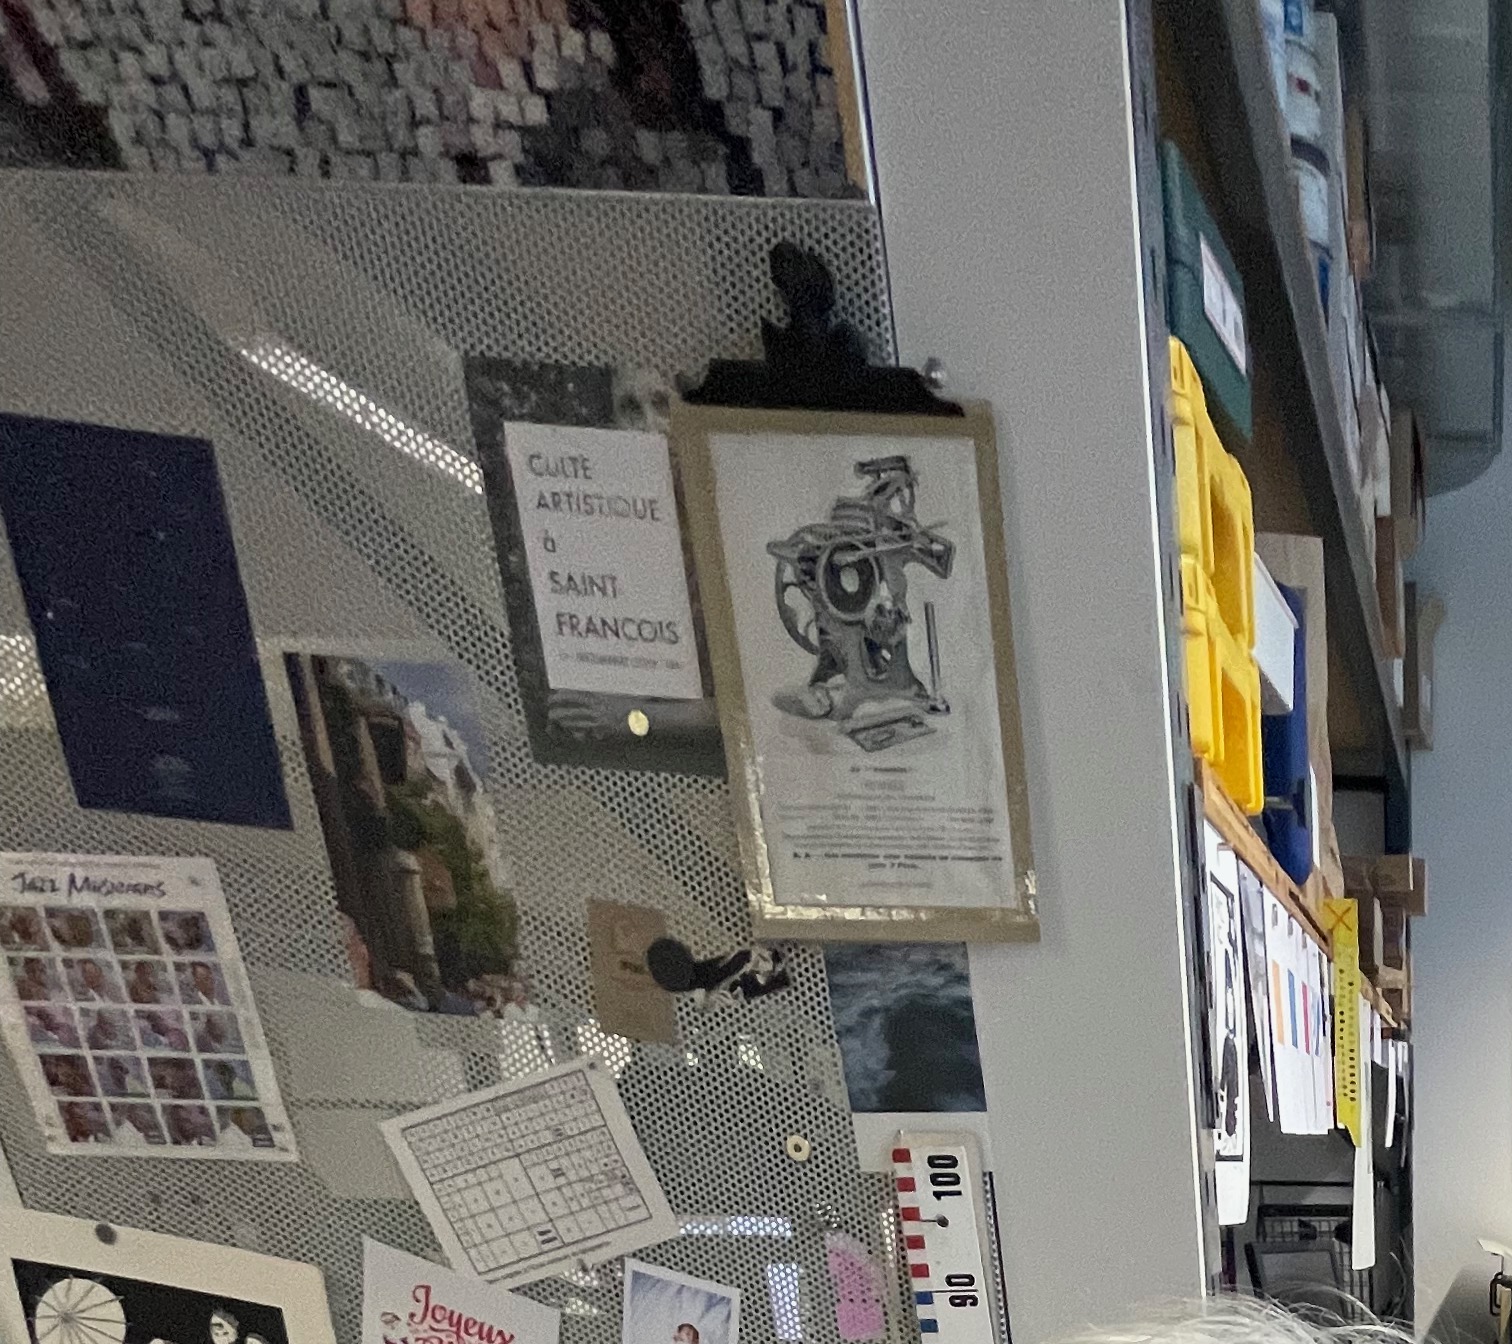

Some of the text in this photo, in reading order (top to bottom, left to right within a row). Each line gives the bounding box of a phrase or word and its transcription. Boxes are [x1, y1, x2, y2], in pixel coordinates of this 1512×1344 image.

[527, 453, 593, 480] CULTE
[535, 490, 662, 523] ARTISTIQUE
[548, 570, 618, 599] SAINT
[926, 1154, 963, 1201] 100
[944, 1273, 979, 1308] 90
